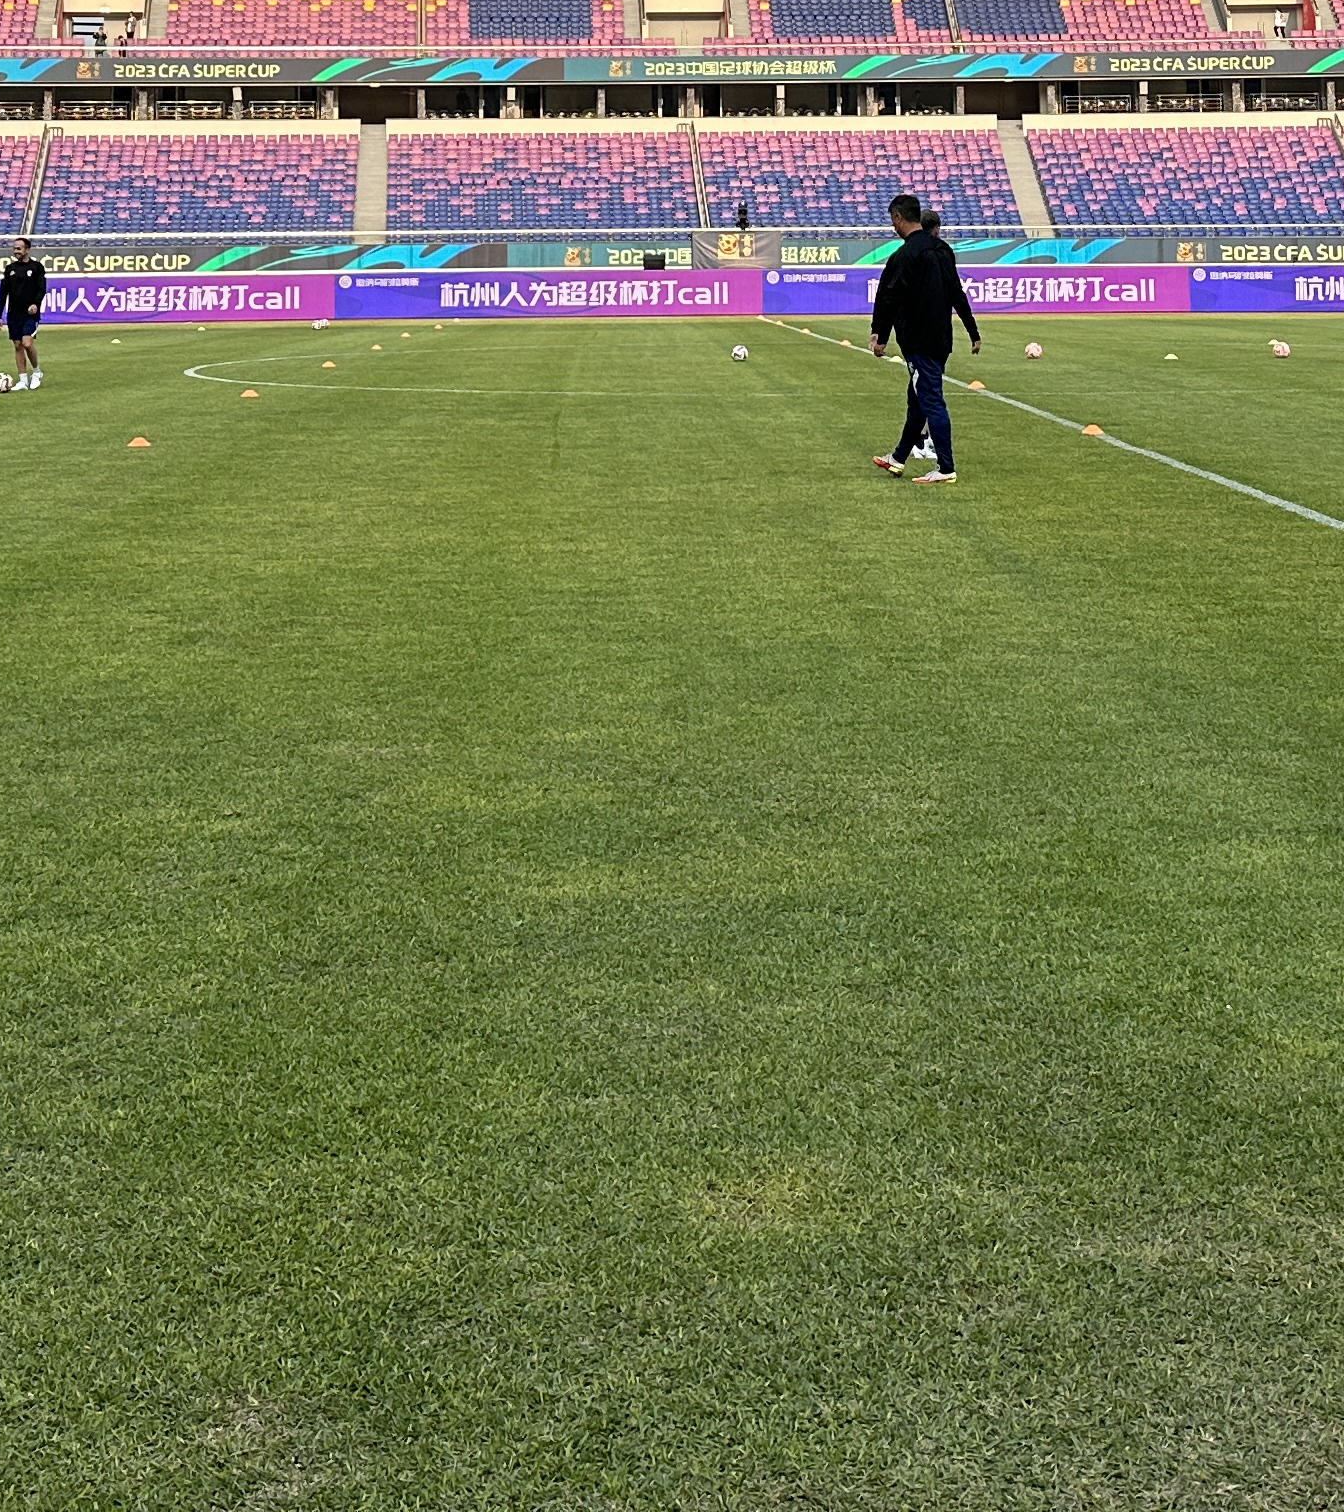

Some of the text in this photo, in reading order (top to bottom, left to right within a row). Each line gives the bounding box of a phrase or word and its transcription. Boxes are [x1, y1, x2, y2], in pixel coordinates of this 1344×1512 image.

[114, 63, 281, 78] 2023 CFA SUPER CUP
[644, 60, 837, 76] 2023中国足球协会超级杯
[1109, 55, 1275, 72] 2023 CFA SUPER CUP
[40, 254, 79, 272] CFA
[84, 254, 151, 271] SUPER
[152, 252, 190, 270] CUP
[1221, 244, 1270, 262] 2023
[1273, 243, 1313, 262] CFA
[6, 285, 300, 313] 州人为超级杯打call
[440, 280, 729, 307] 杭州人为超级杯打call
